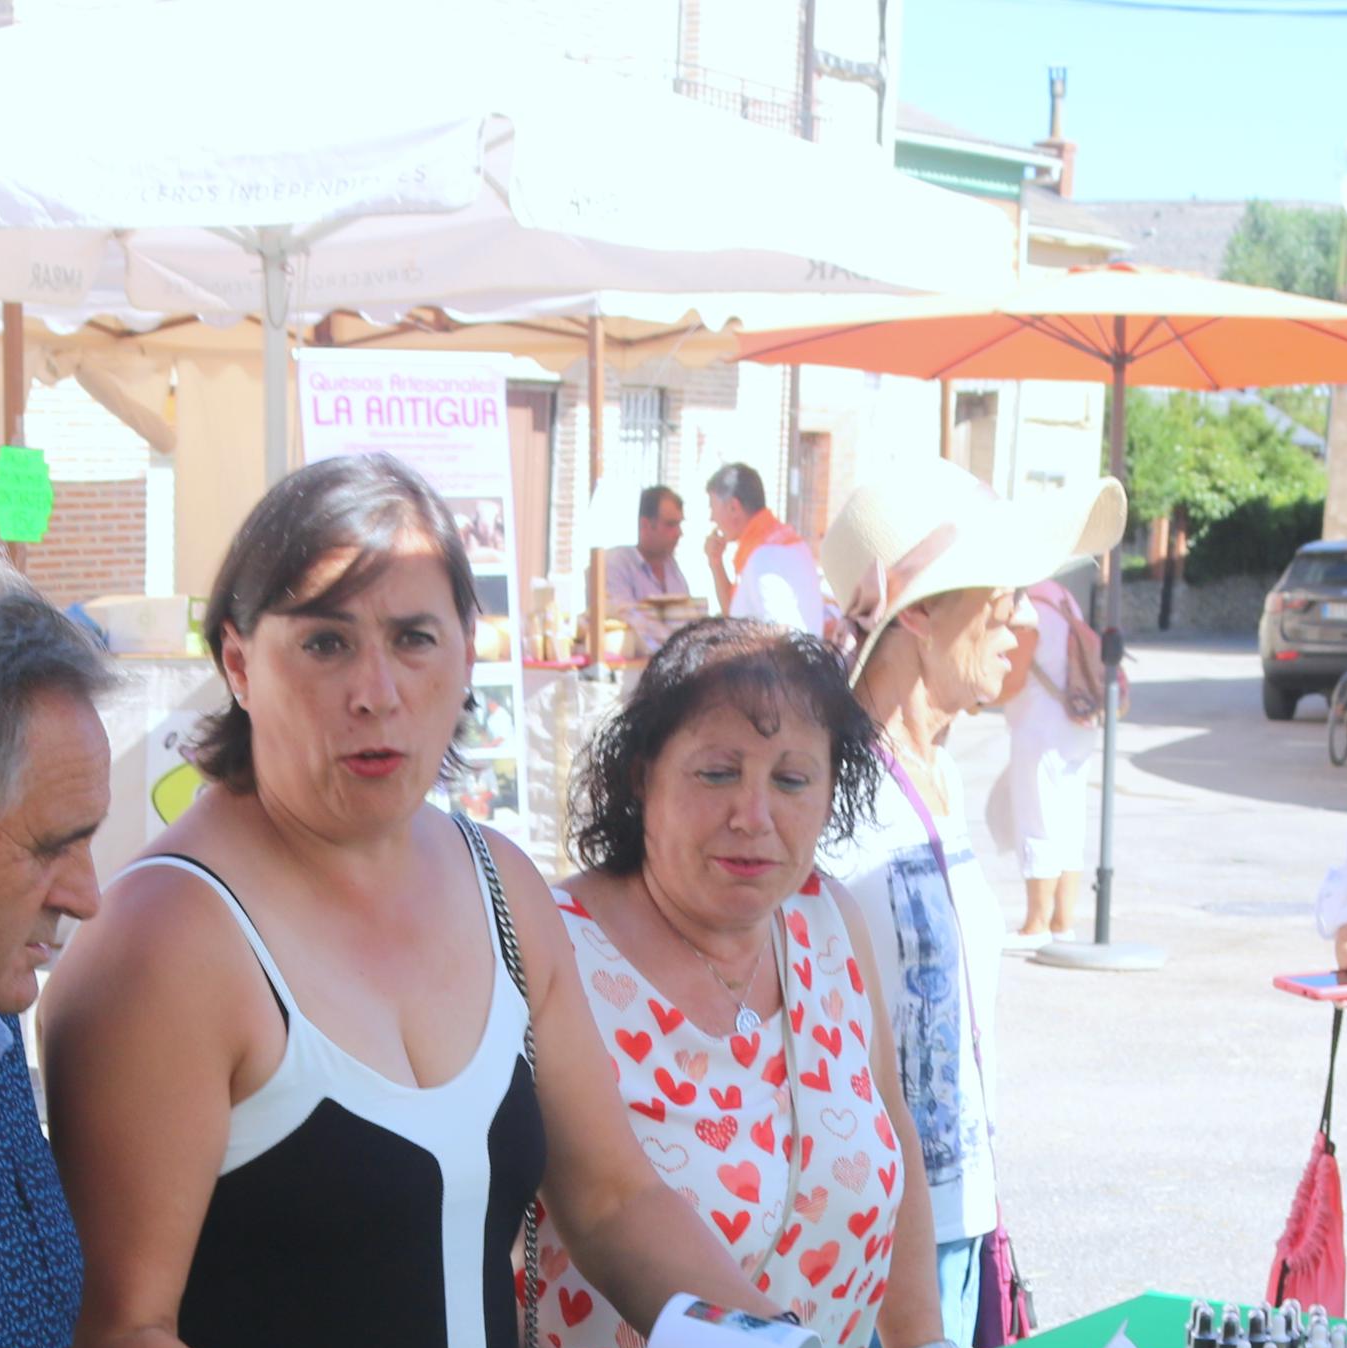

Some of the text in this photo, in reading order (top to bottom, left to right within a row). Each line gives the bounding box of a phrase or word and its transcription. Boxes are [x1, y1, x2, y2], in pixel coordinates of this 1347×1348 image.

[309, 371, 498, 394] Quesos Artesanales
[312, 395, 499, 428] LA ANTIGUA
